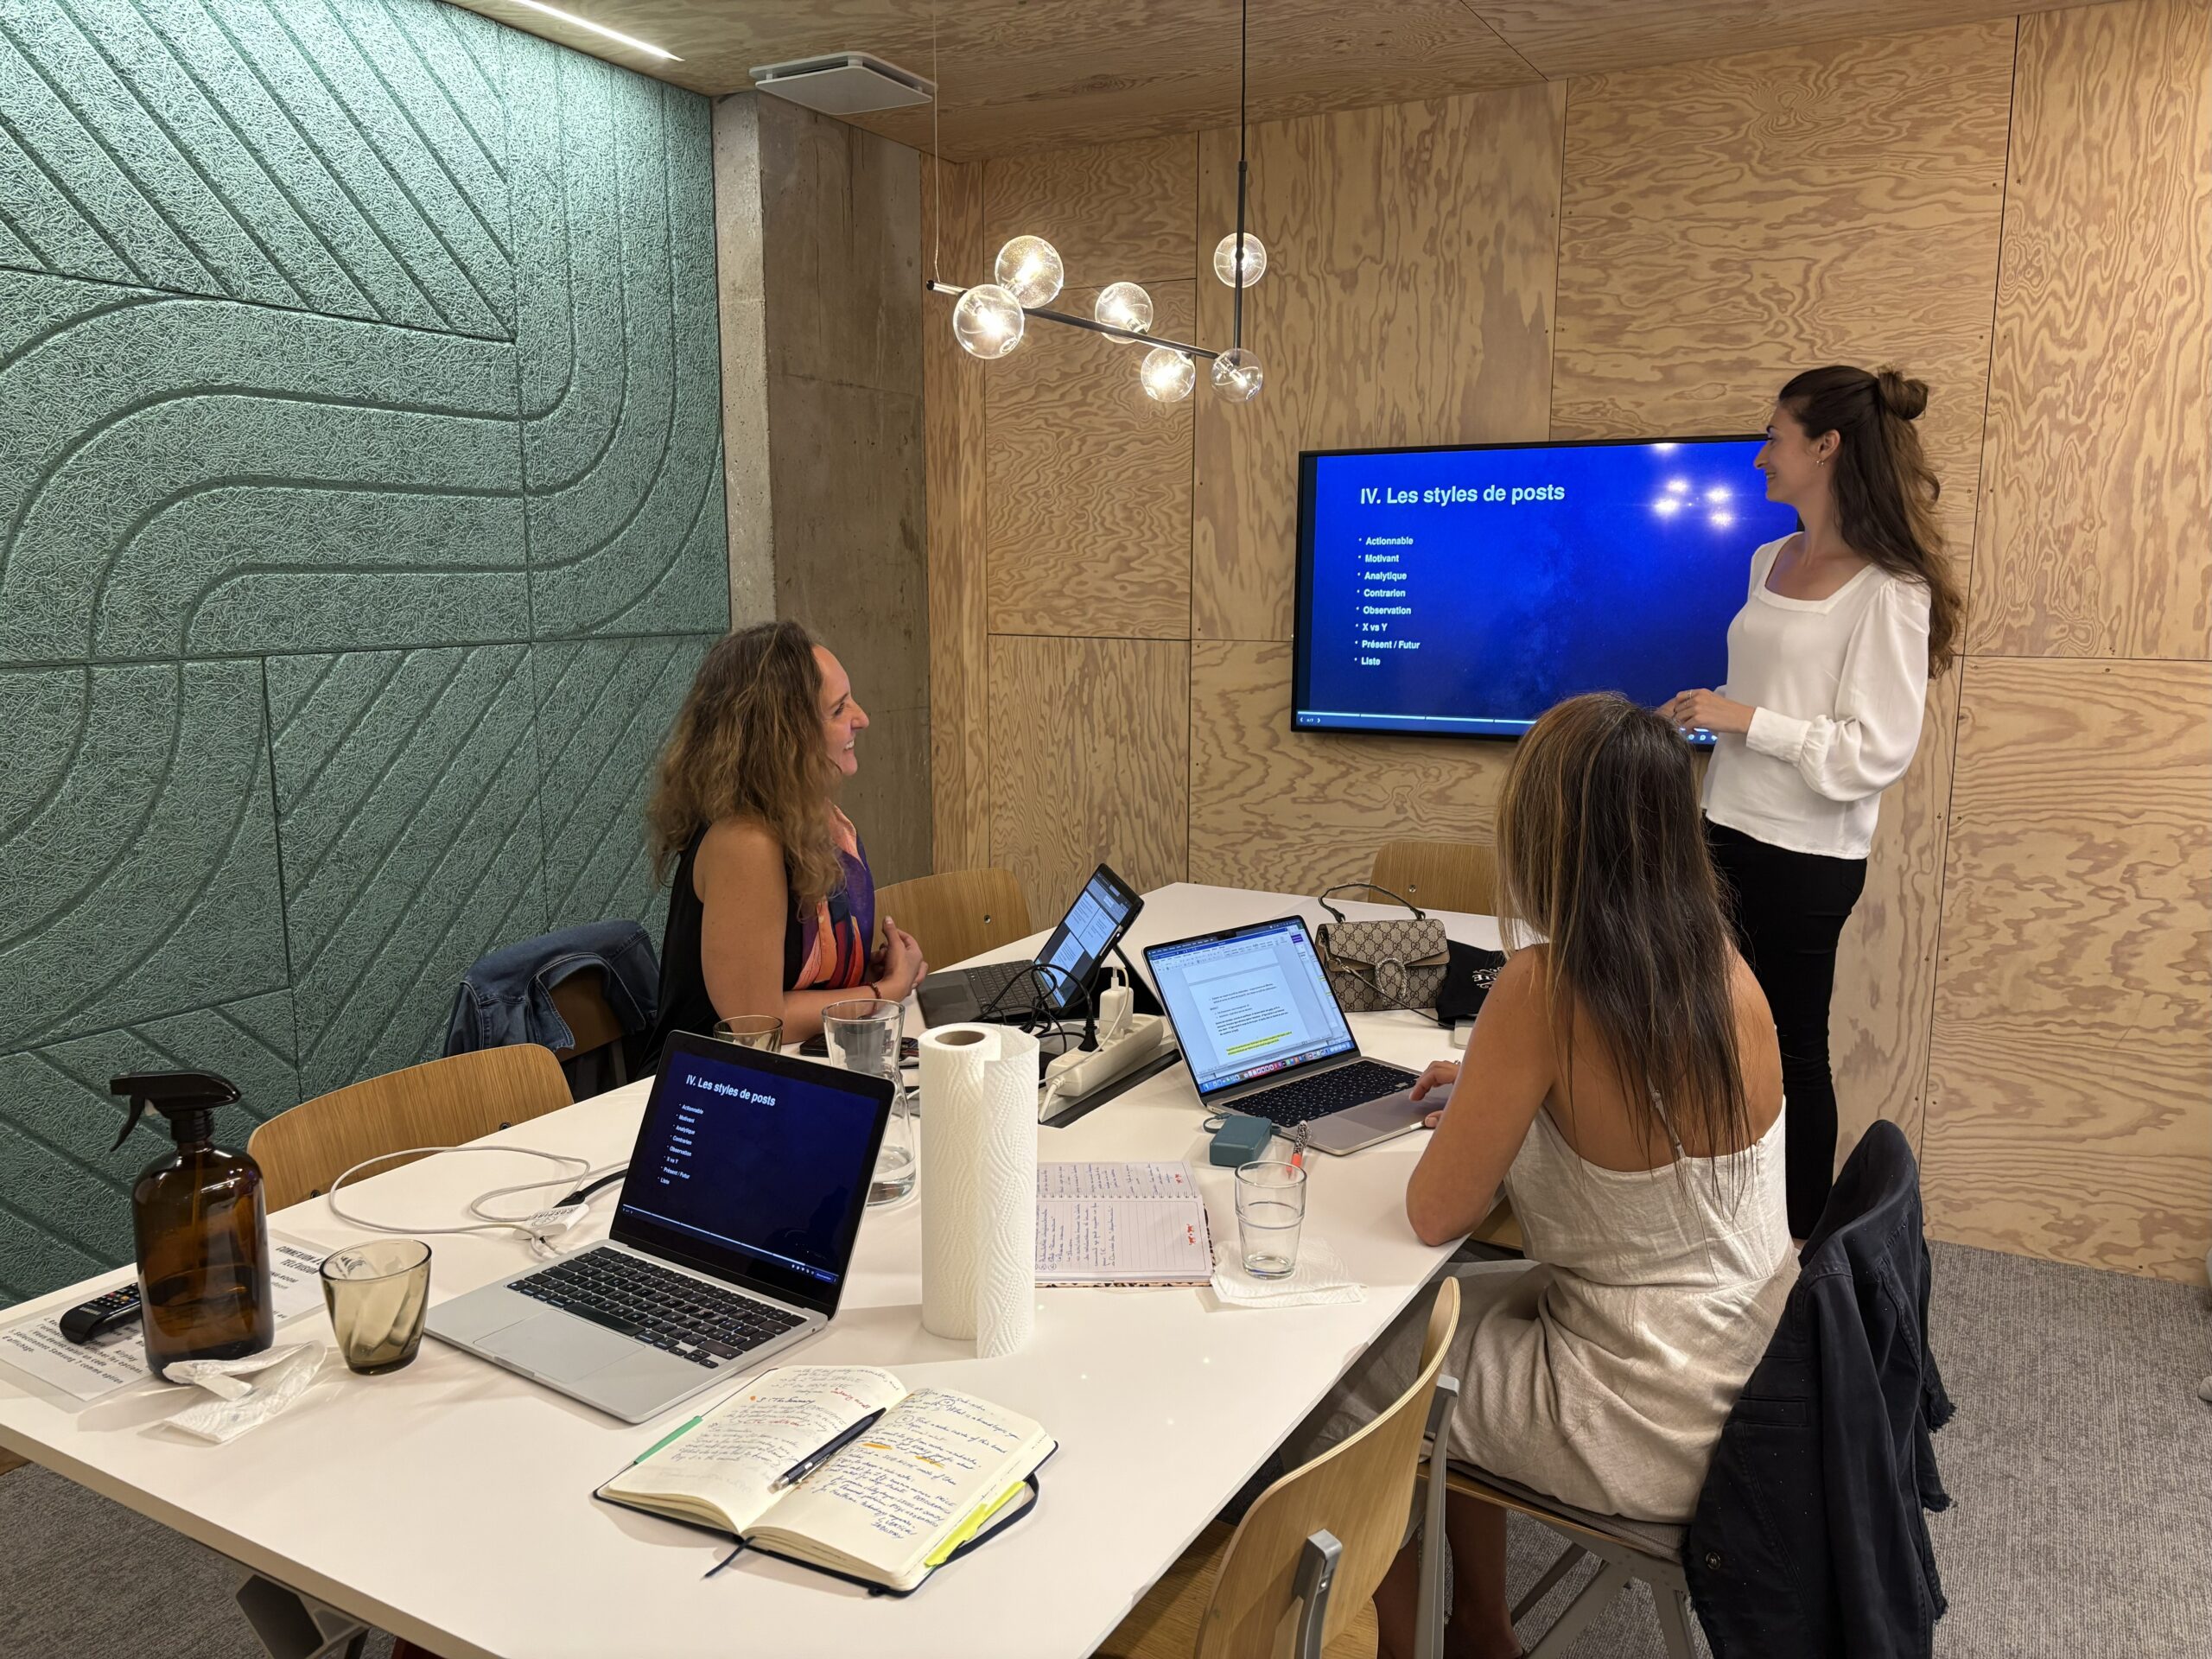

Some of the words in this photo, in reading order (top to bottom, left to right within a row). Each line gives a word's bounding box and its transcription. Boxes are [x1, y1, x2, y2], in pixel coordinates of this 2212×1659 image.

[1360, 487, 1381, 505] IV.
[1387, 487, 1419, 504] Les
[1423, 486, 1478, 506] styles
[1483, 485, 1506, 501] de
[1511, 485, 1565, 505] posts
[1365, 536, 1414, 546] Actionnable
[1364, 554, 1399, 563] Motivant
[1364, 571, 1408, 582] Analytique
[1363, 606, 1412, 614] Observation
[1362, 622, 1369, 631] X
[1381, 622, 1388, 632] Y
[1362, 639, 1392, 649] Présent
[1398, 640, 1421, 649] Futur
[1361, 657, 1381, 665] Liste
[686, 1074, 696, 1086] IV.
[697, 1077, 713, 1090] Les
[714, 1083, 739, 1096] styles
[740, 1089, 751, 1100] de
[751, 1093, 776, 1107] posts
